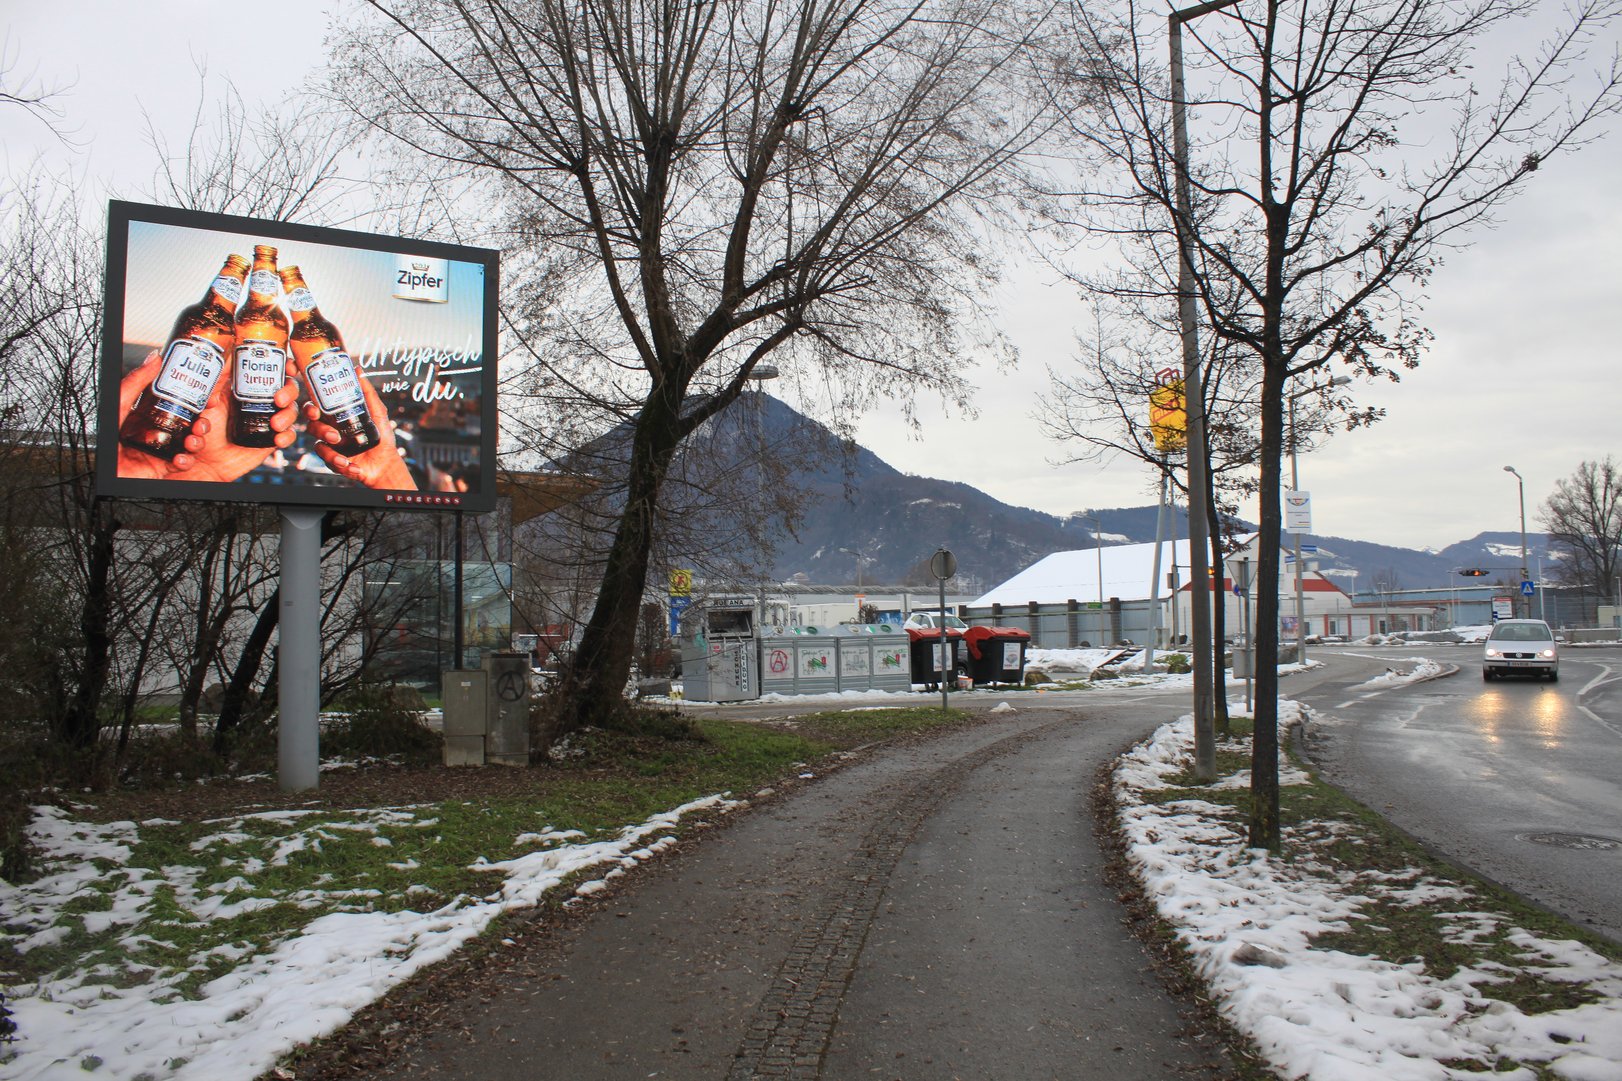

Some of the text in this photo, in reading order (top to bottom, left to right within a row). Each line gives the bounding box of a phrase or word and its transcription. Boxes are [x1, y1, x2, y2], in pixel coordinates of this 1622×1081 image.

[397, 269, 443, 290] Zipfer
[241, 359, 279, 373] Florian
[359, 333, 482, 378] Urtypisch
[179, 356, 212, 379] Julia
[318, 366, 351, 385] Sarah
[243, 372, 275, 387] Urtyp
[382, 363, 465, 404] wie du.
